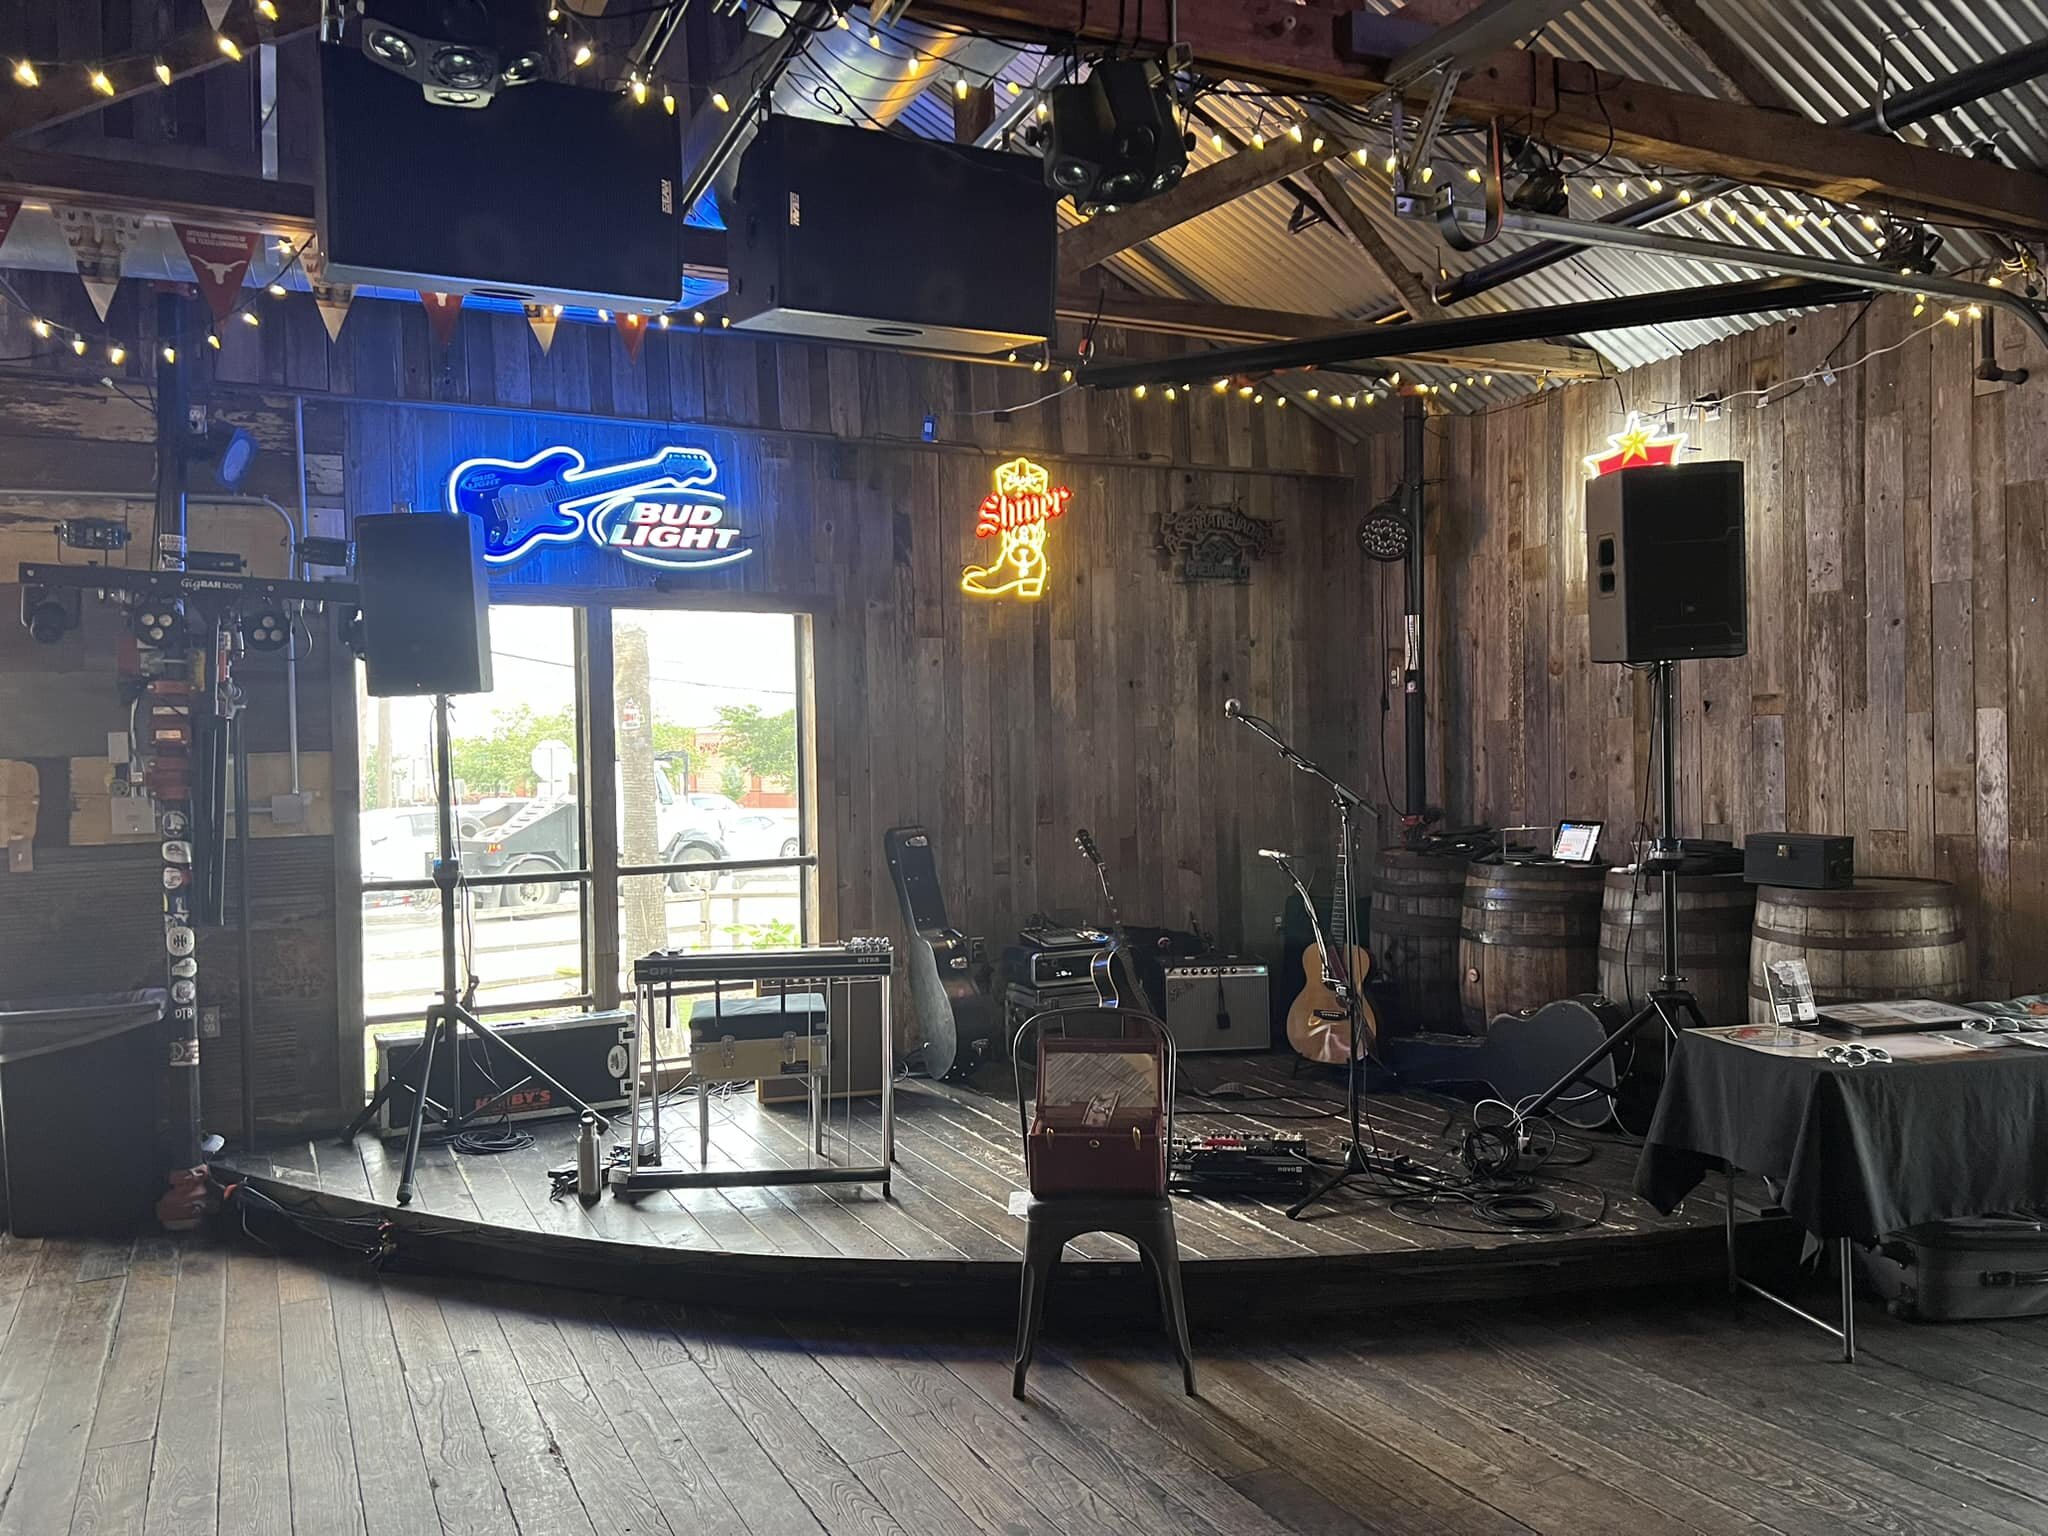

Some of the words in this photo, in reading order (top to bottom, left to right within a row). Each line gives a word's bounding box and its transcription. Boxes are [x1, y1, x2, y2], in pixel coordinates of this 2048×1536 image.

[630, 502, 723, 527] BUD
[976, 486, 1072, 539] Shiner
[608, 524, 740, 549] LIGHT
